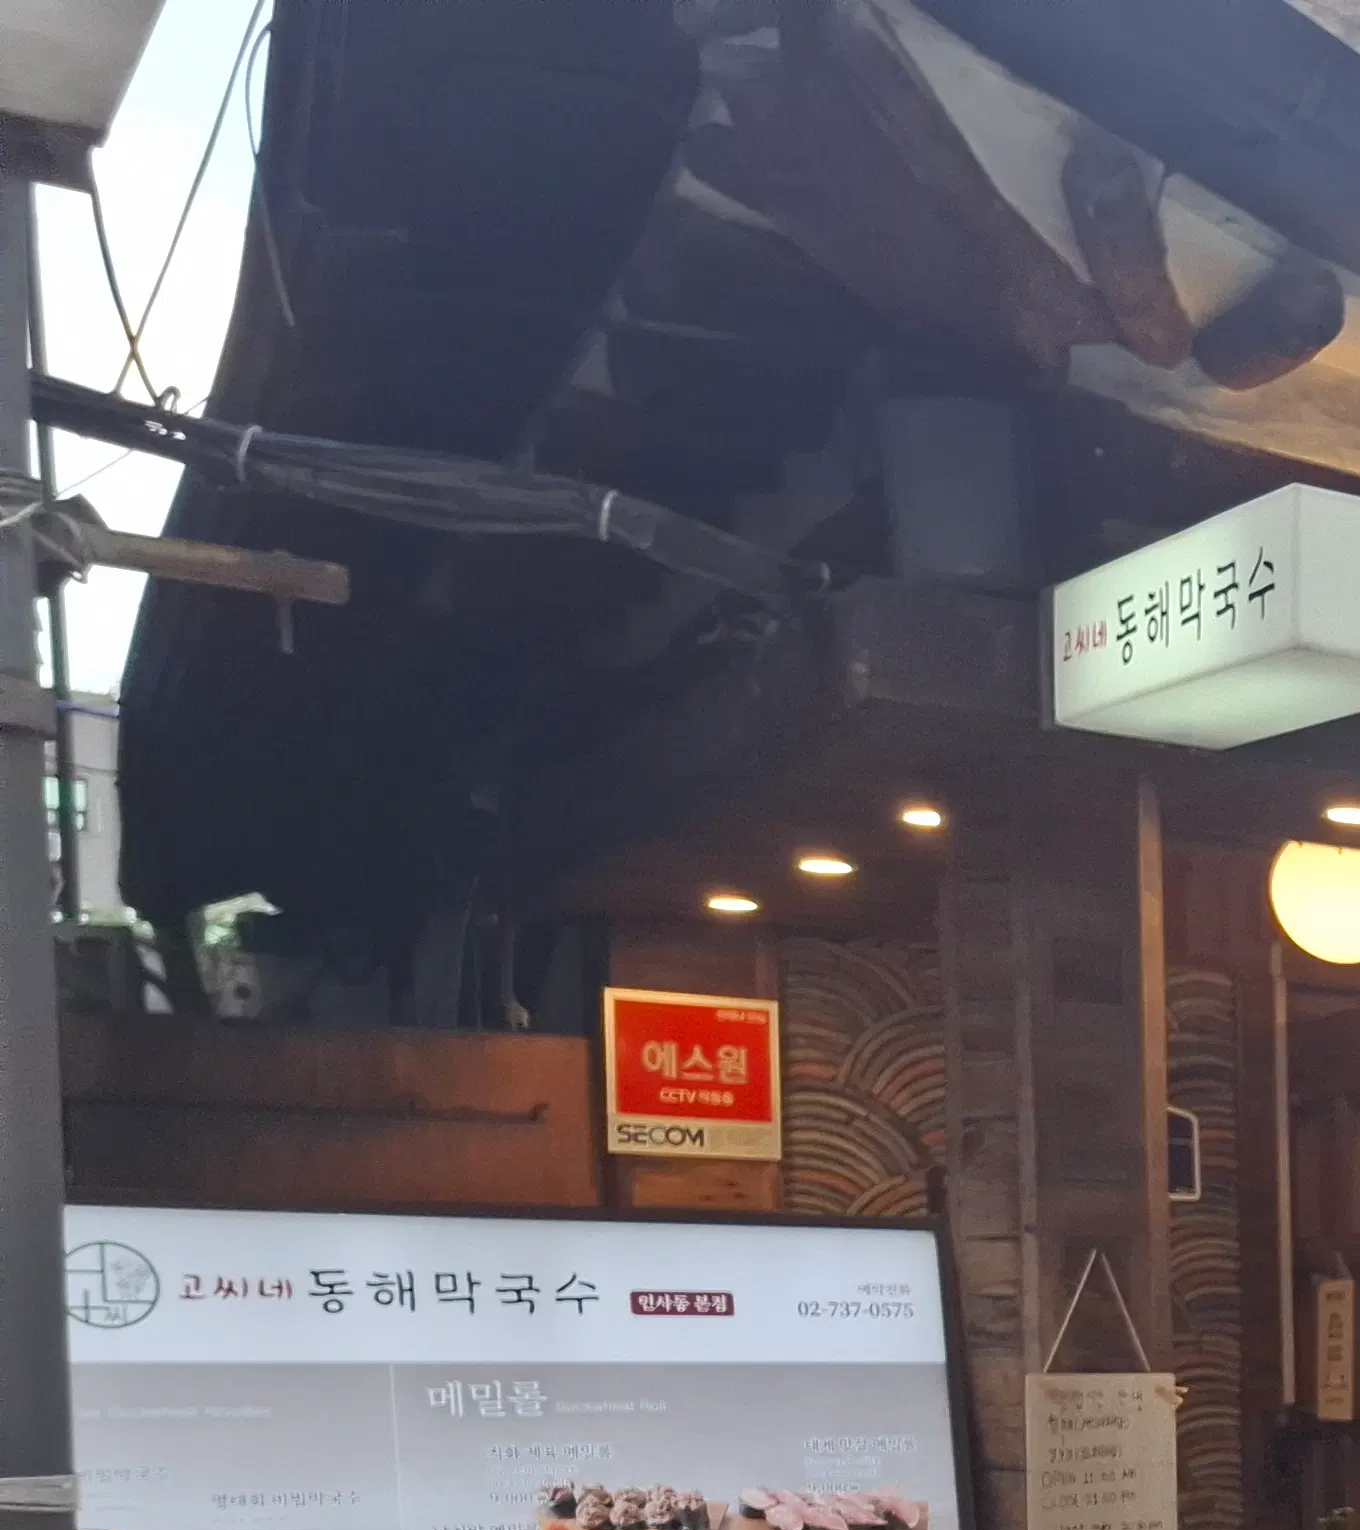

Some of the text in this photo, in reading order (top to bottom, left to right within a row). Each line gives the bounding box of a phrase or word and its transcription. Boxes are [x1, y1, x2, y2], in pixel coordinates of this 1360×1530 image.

[1063, 546, 1276, 666] 고씨네 동해막국수
[641, 1040, 748, 1084] 에스원
[659, 1086, 696, 1105] CCTV
[616, 1123, 705, 1148] SECOM
[179, 1269, 600, 1314] 고씨네 동해막국수
[639, 1293, 690, 1313] 인사동
[797, 1300, 915, 1319] 02-737-0575
[427, 1380, 548, 1418] 메밀롤
